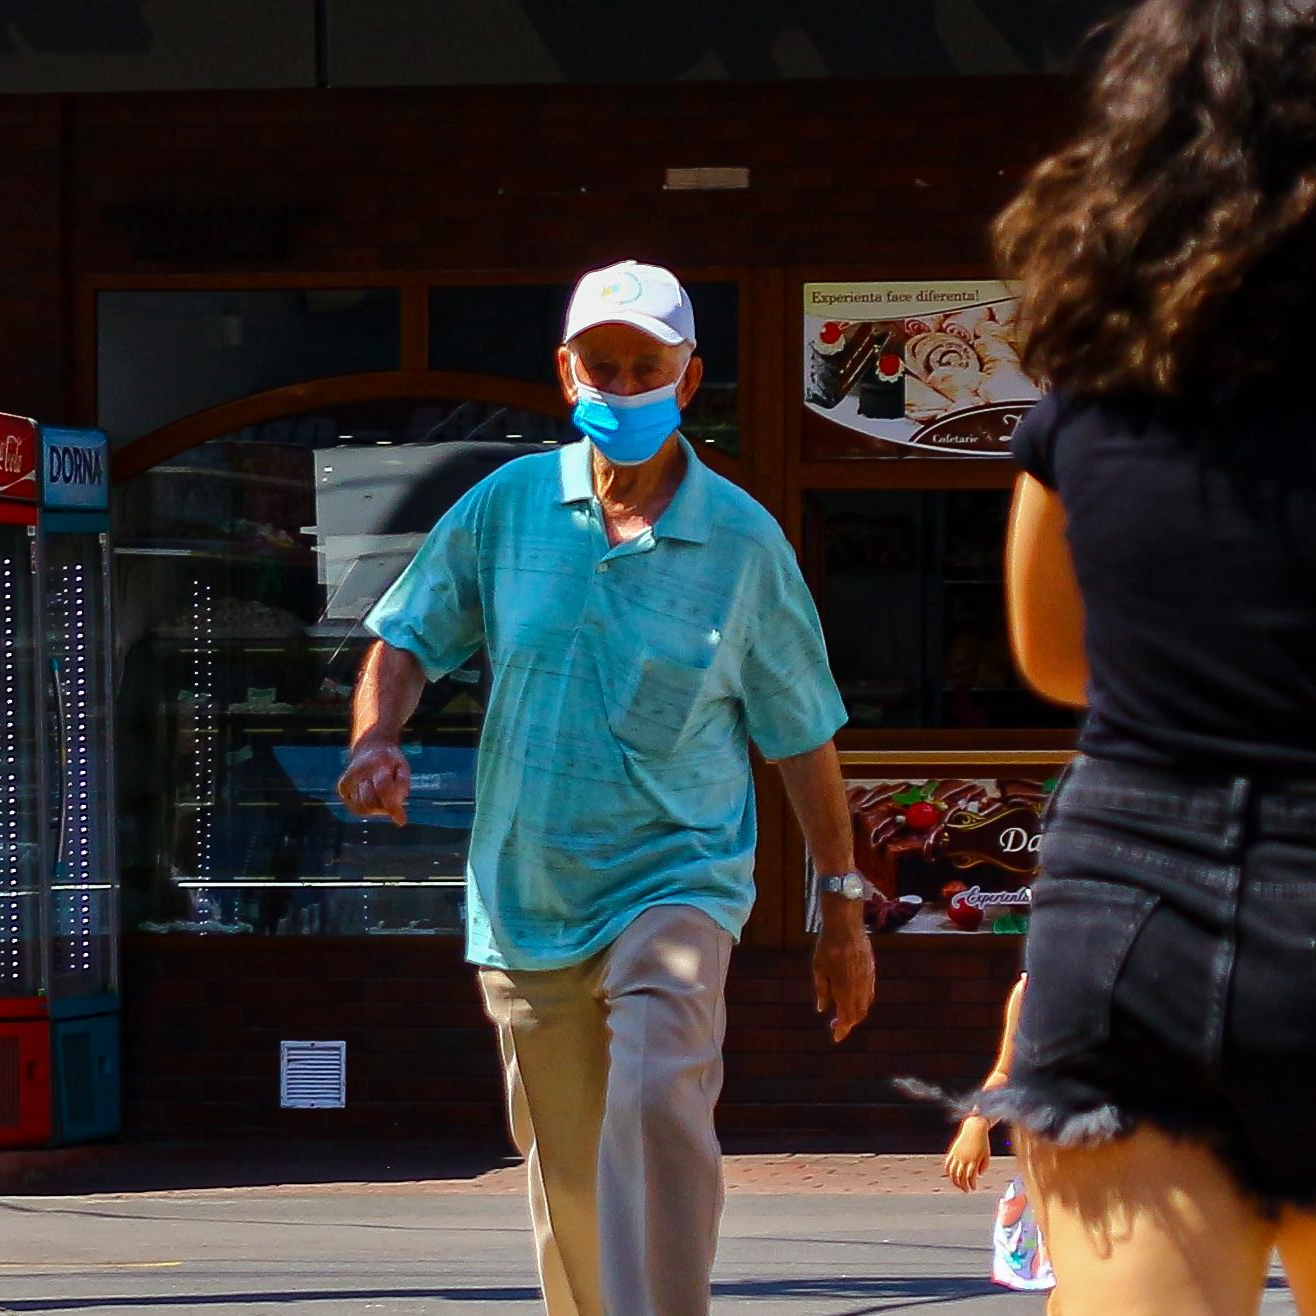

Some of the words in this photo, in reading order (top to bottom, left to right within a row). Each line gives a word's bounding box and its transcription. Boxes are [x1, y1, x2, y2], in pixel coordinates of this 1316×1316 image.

[887, 290, 913, 302] face
[49, 445, 104, 485] DORNA
[999, 827, 1043, 853] Da
